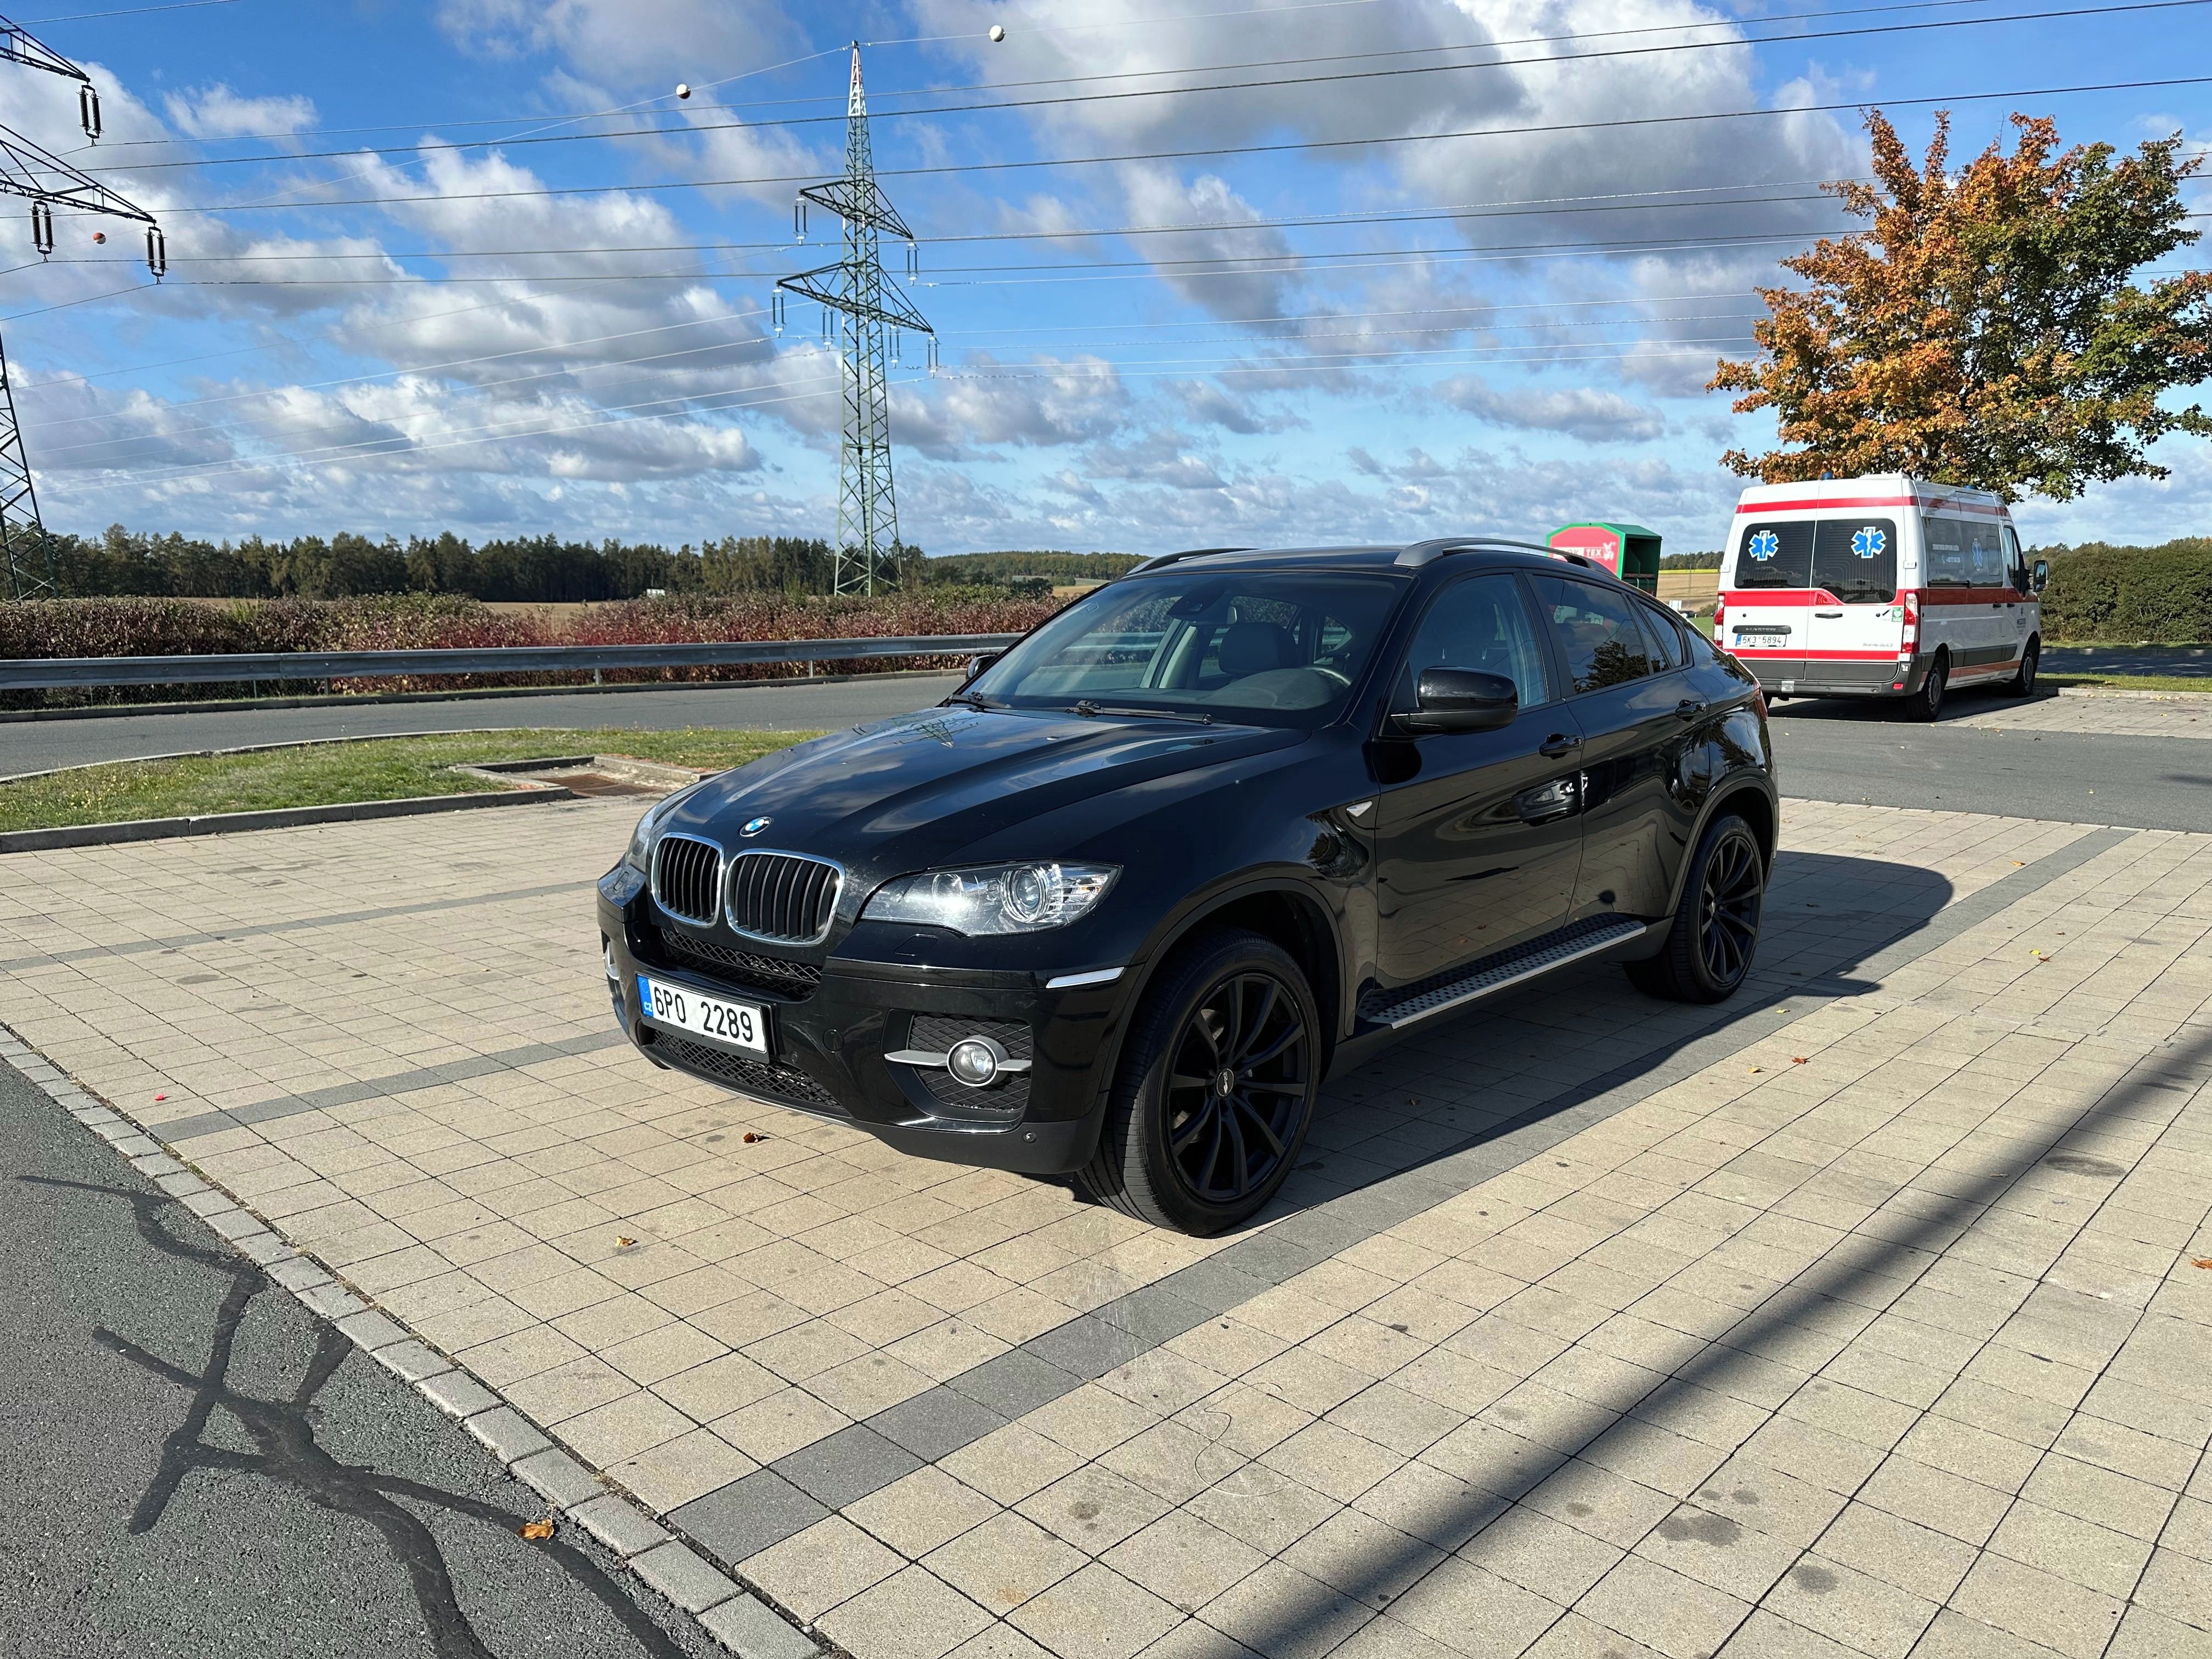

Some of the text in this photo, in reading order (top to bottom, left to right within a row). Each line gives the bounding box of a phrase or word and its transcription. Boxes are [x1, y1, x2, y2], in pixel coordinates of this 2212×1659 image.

[1585, 549, 1602, 557] TEX
[644, 1001, 653, 1012] CZ
[700, 1001, 753, 1042] 2289
